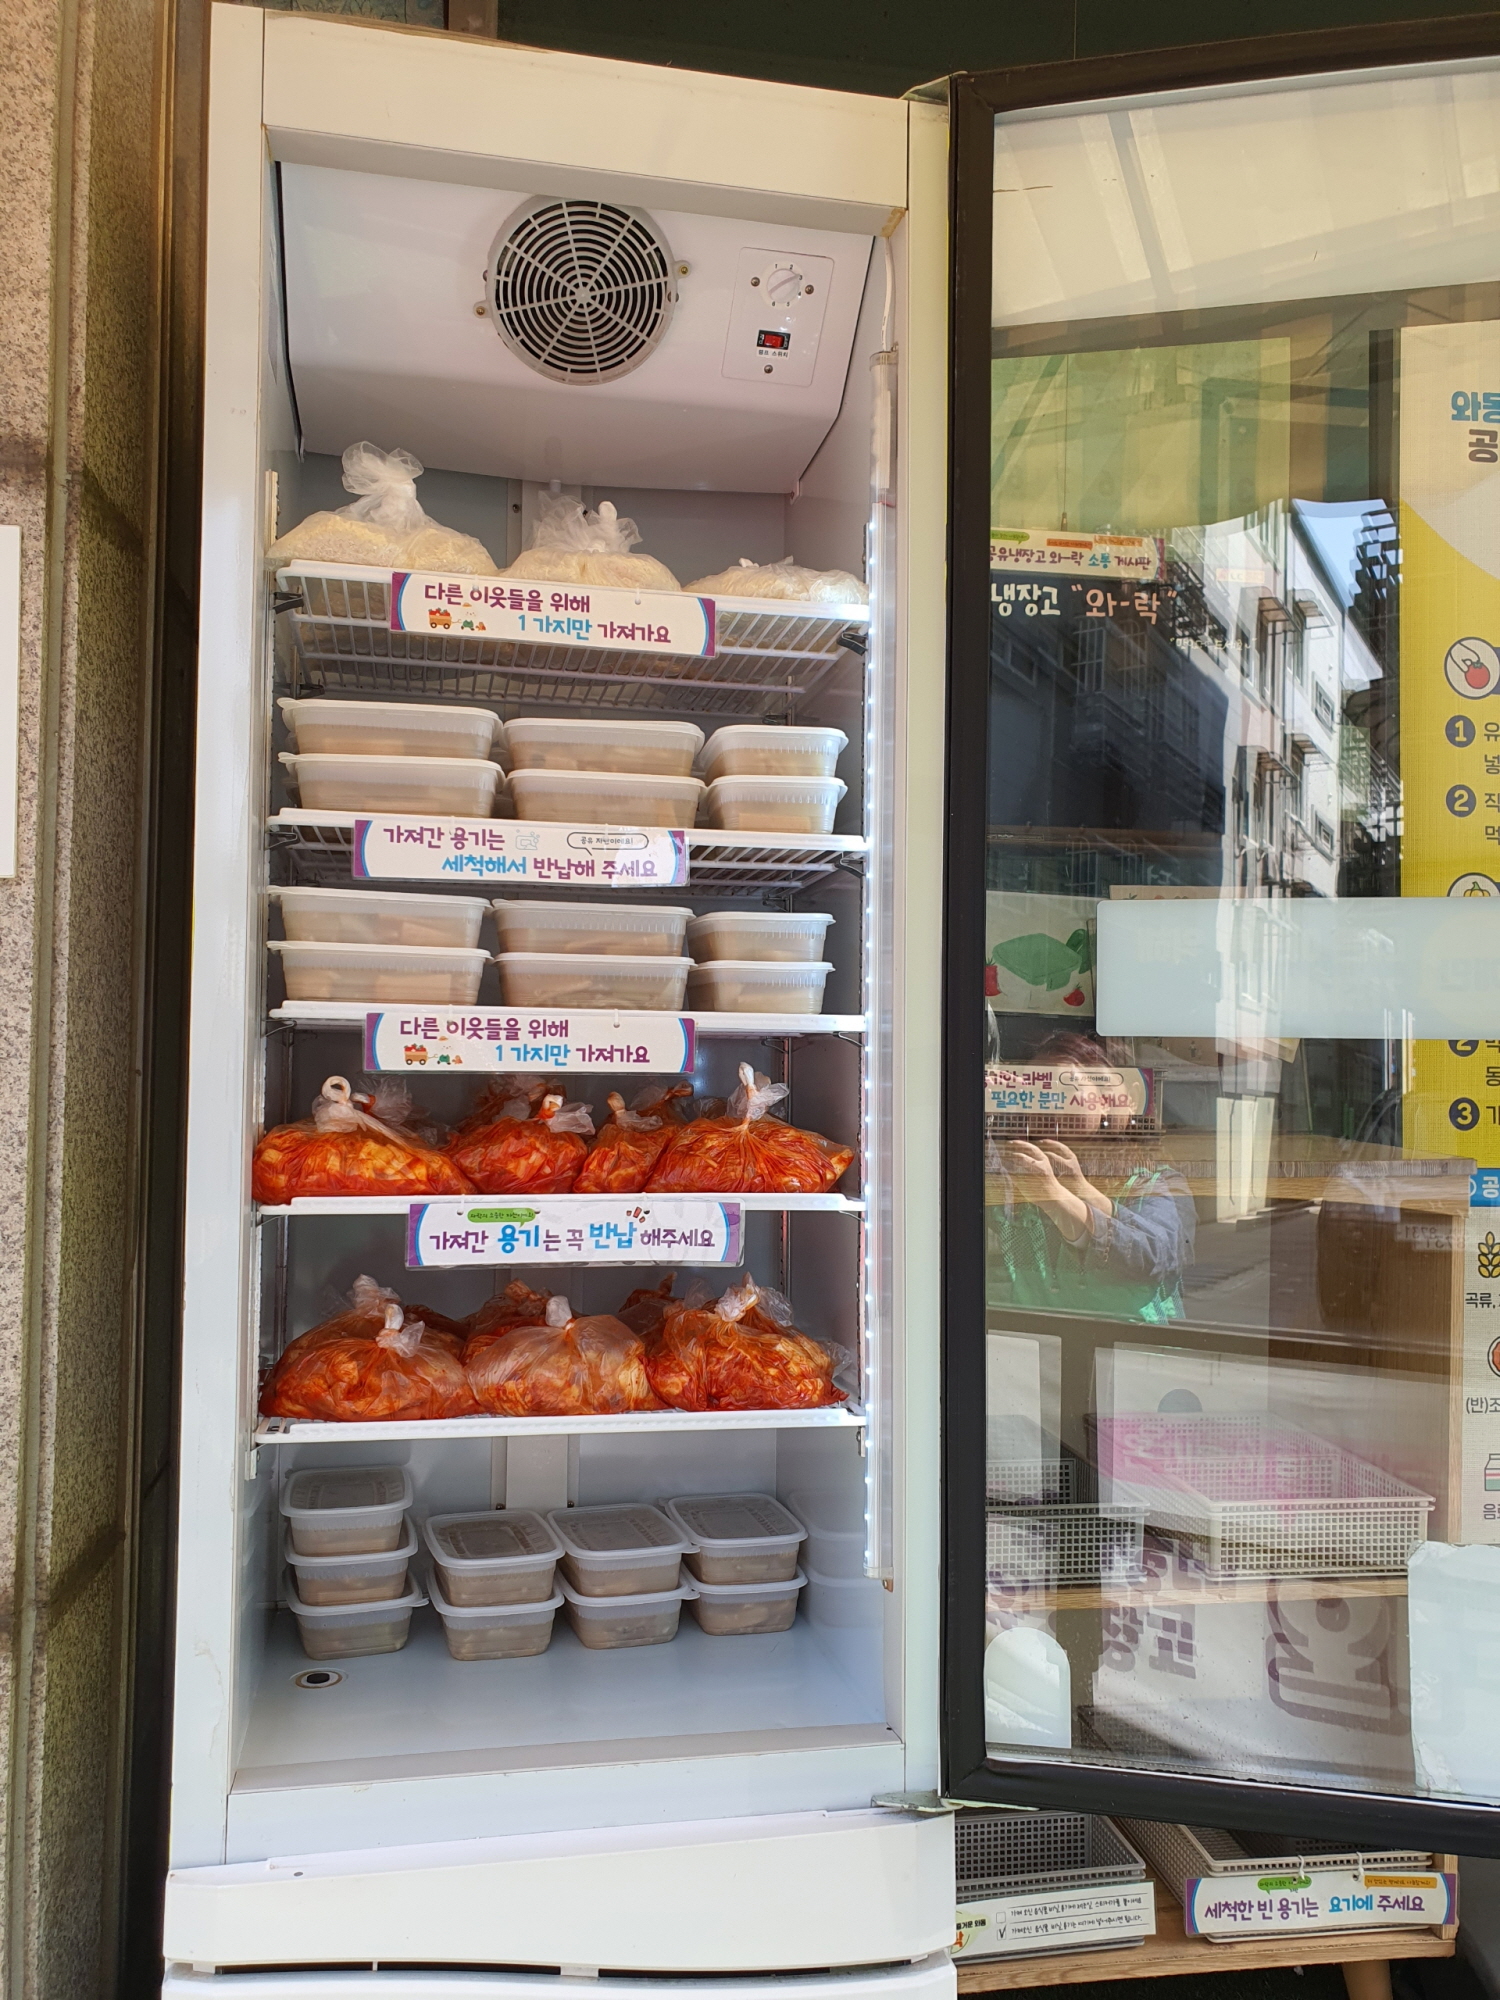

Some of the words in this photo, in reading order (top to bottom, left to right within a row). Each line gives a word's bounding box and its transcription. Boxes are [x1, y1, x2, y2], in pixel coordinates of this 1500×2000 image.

[1088, 553, 1111, 569] 소통
[1114, 555, 1152, 571] 게시판
[424, 582, 463, 606] 다른
[470, 586, 543, 613] 이웃들을
[550, 593, 591, 614] 위해
[991, 583, 1061, 617] 냉장고
[518, 614, 527, 631] 1
[533, 615, 592, 641] 가지만
[597, 622, 672, 643] 가져가요
[1454, 789, 1470, 812] 2
[383, 825, 445, 848] 가져간
[449, 827, 506, 851] 용기는
[441, 854, 527, 877] 세척해서
[533, 857, 595, 880] 반납해
[601, 859, 658, 880] 주세요
[399, 1017, 440, 1040] 다른
[446, 1018, 521, 1041] 이웃들을
[528, 1019, 569, 1039] 위해
[495, 1044, 503, 1062] 1
[510, 1044, 571, 1066] 가지만
[576, 1045, 650, 1063] 가져가요
[991, 1090, 1035, 1109] 필요한
[1037, 1090, 1067, 1110] 분만
[1456, 1102, 1473, 1125] 3
[429, 1230, 489, 1254] 가져간
[497, 1224, 562, 1254] 용기는
[565, 1228, 584, 1251] 꼭
[1483, 1503, 1500, 1520] 음
[1204, 1899, 1254, 1921] 세척한
[1258, 1899, 1273, 1920] 빈
[1277, 1897, 1319, 1920] 용기는
[1328, 1894, 1373, 1913] 요기에
[1377, 1894, 1425, 1912] 주세요
